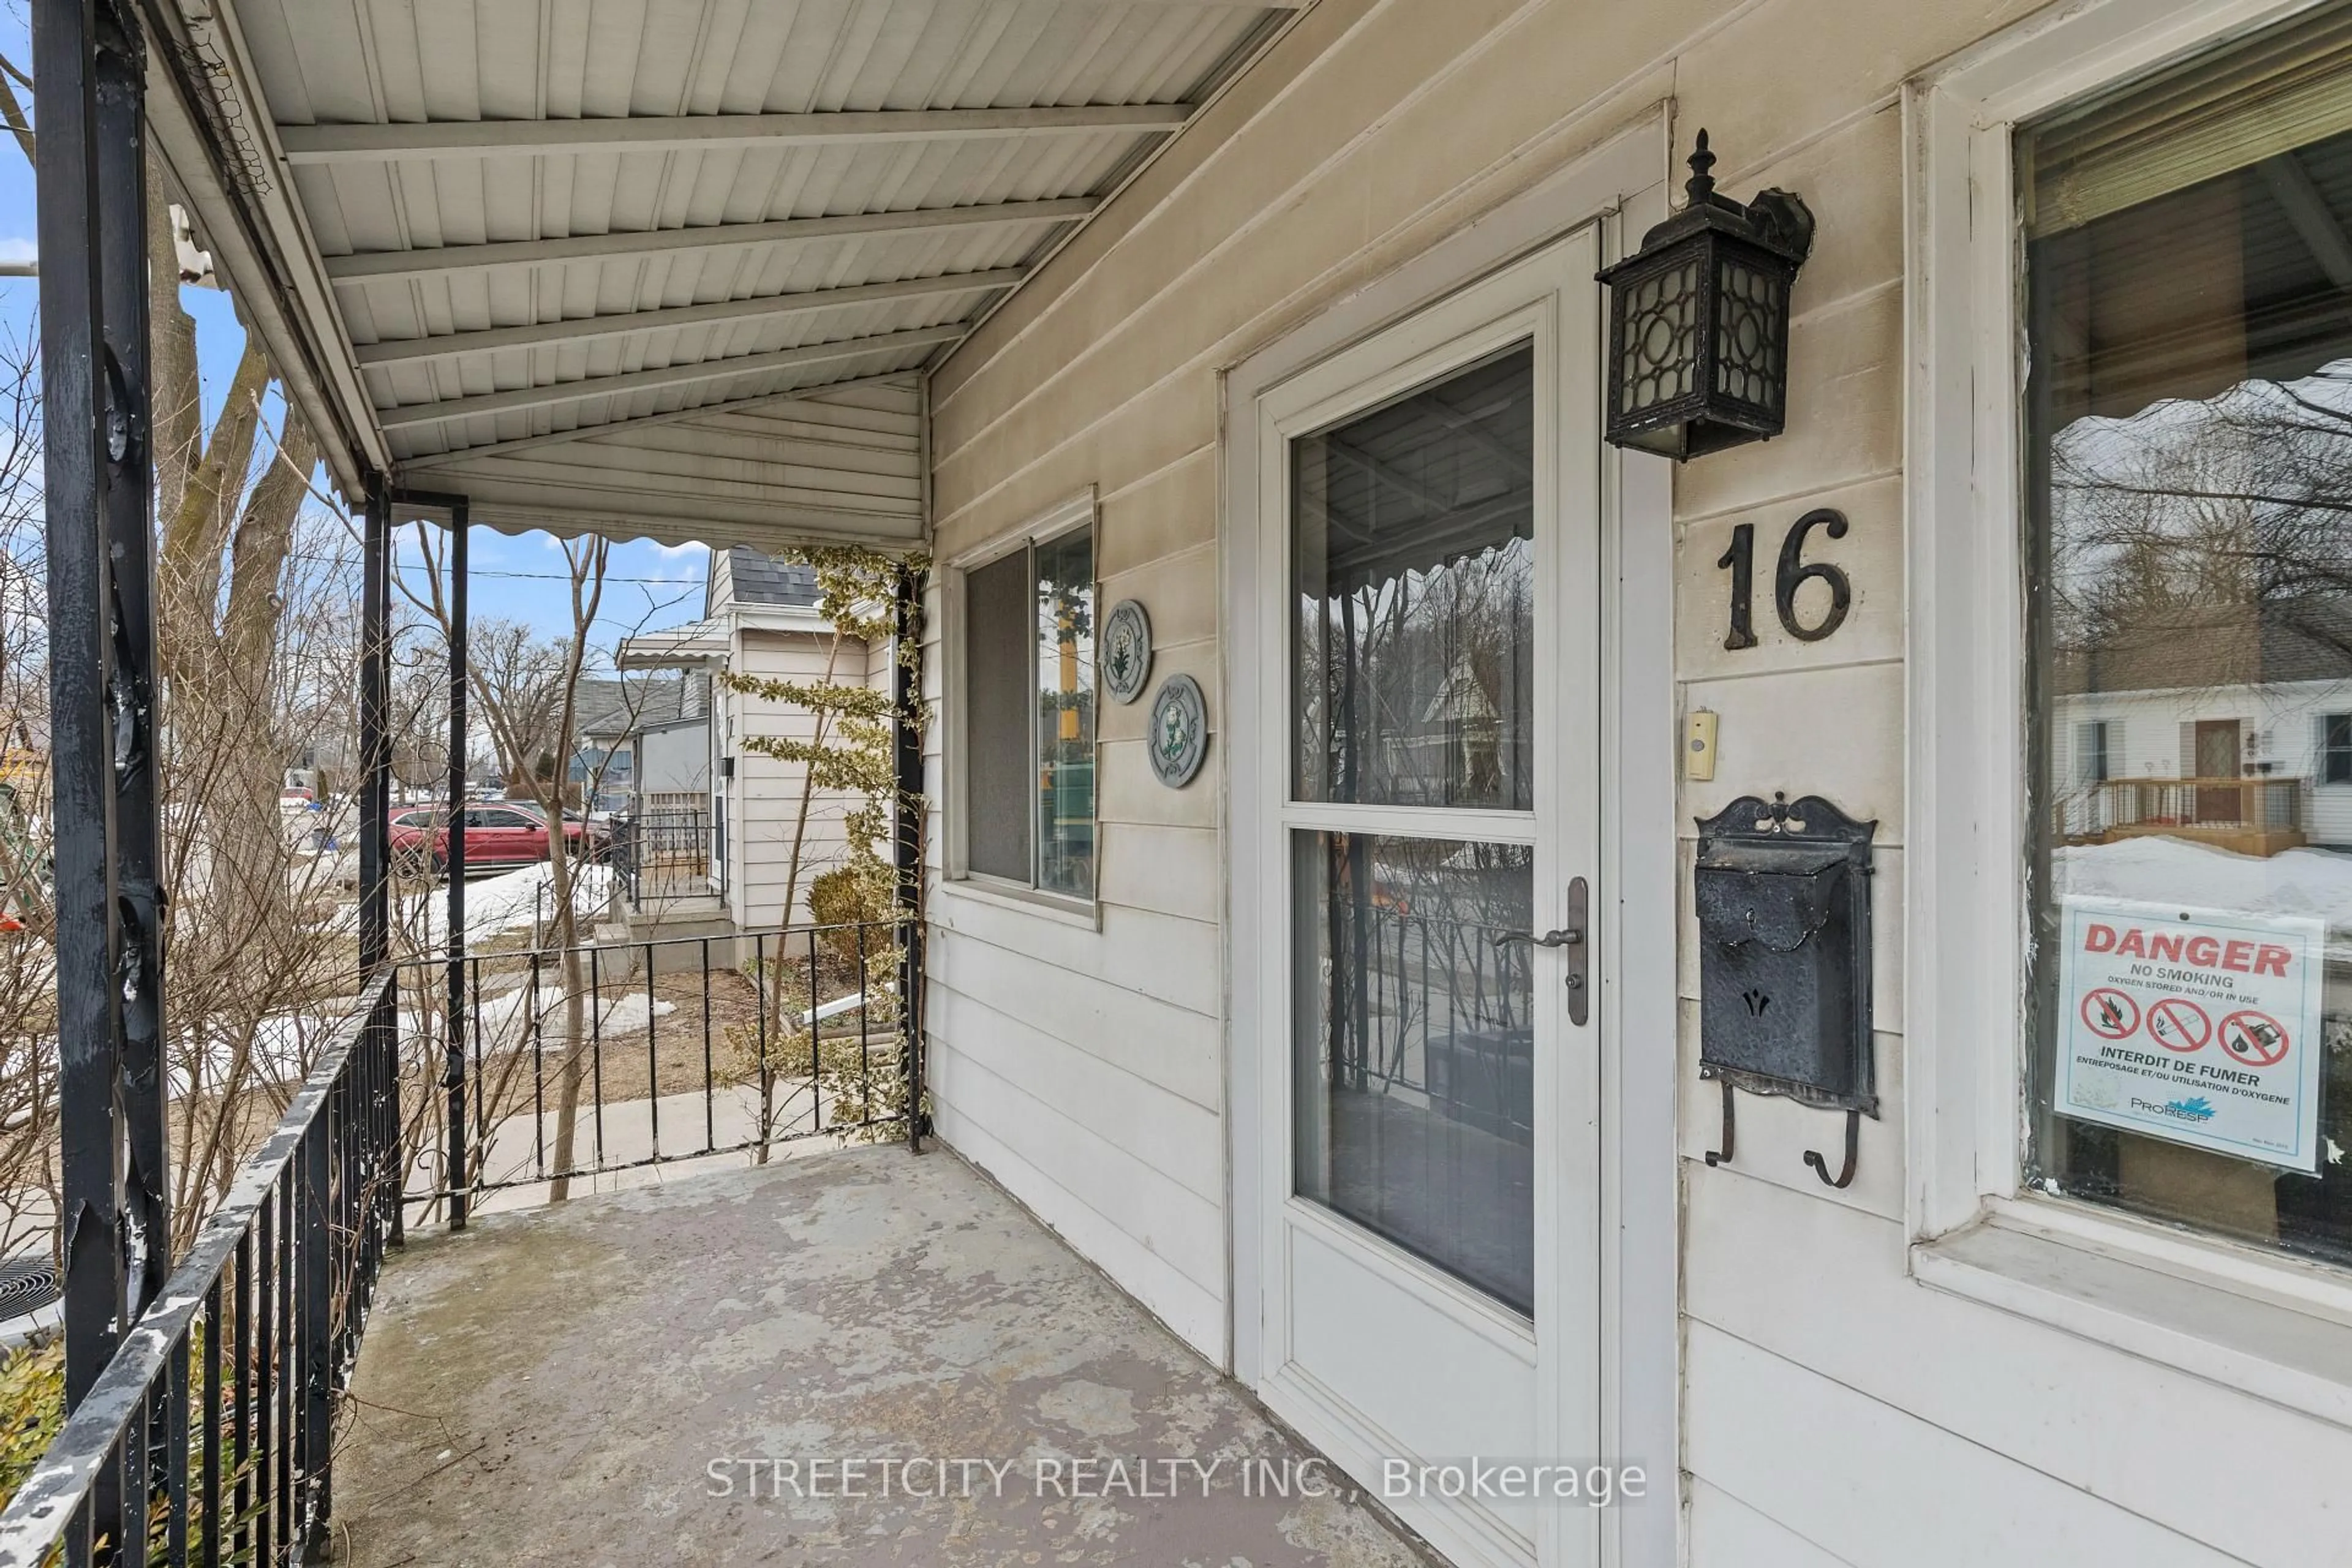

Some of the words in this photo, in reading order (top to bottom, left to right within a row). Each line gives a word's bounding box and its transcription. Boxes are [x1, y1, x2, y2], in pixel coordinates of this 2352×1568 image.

[1717, 508, 1850, 650] 16
[2084, 924, 2291, 978] DANGER
[2108, 976, 2143, 987] OXYGEN
[2146, 981, 2182, 992] STORED
[2184, 987, 2223, 999] AND/OR
[2130, 963, 2152, 976] NO
[2156, 968, 2234, 988] SMOKING
[2076, 1056, 2139, 1074] ENTREPOSAGE
[2141, 1069, 2169, 1080] ET/OU
[2172, 1075, 2229, 1093] UTILISATION
[2101, 1046, 2170, 1069] INTERDIT
[2174, 1060, 2196, 1074] DE
[2199, 1066, 2260, 1087] FUMER
